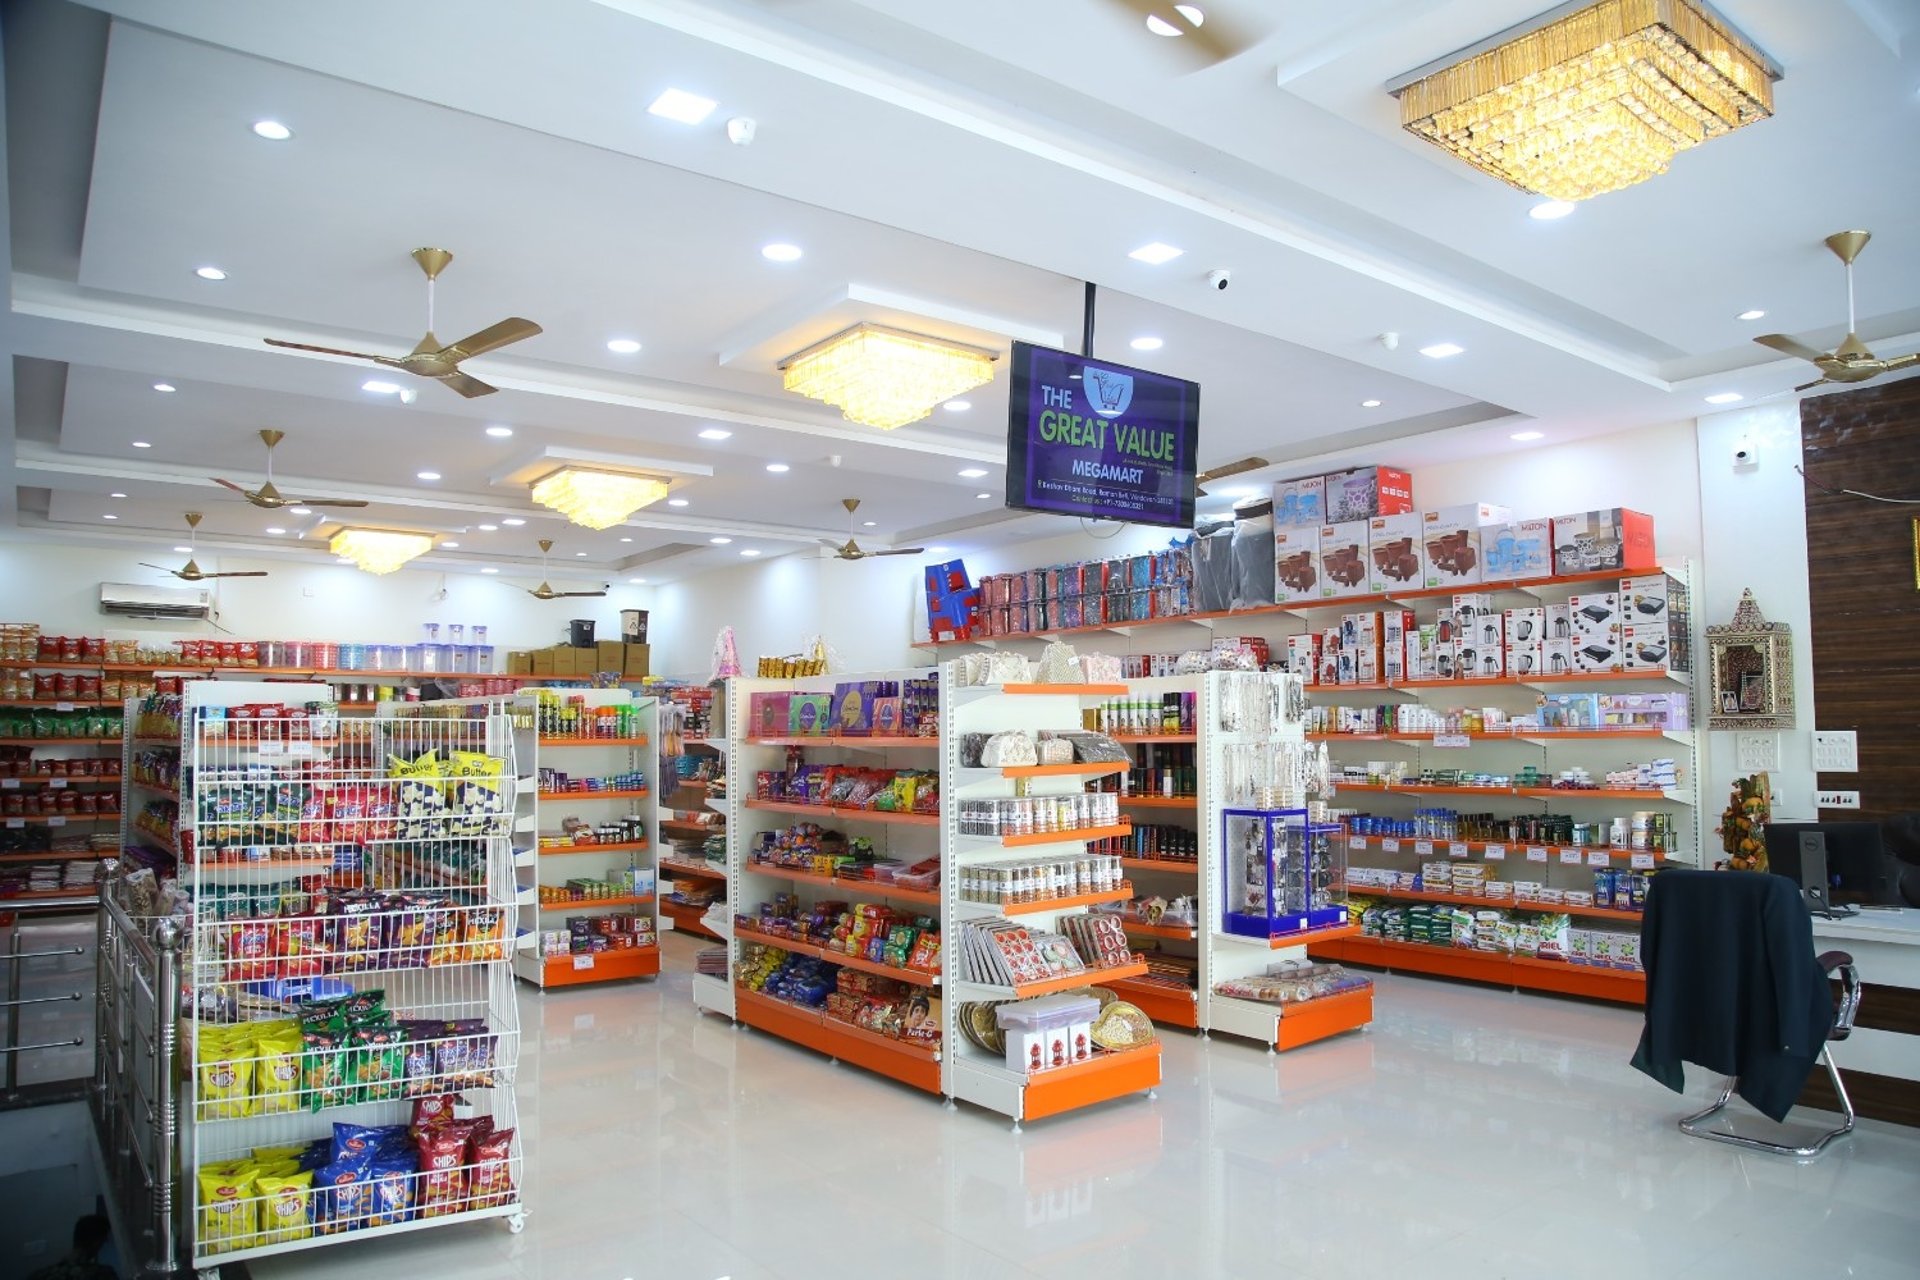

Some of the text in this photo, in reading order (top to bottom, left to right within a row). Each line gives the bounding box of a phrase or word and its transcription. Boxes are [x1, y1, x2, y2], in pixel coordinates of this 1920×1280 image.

[1041, 385, 1072, 409] THE
[1039, 409, 1175, 462] GREAT VALUE
[1071, 459, 1144, 484] MEGAMART
[433, 1154, 458, 1168] CHIPS
